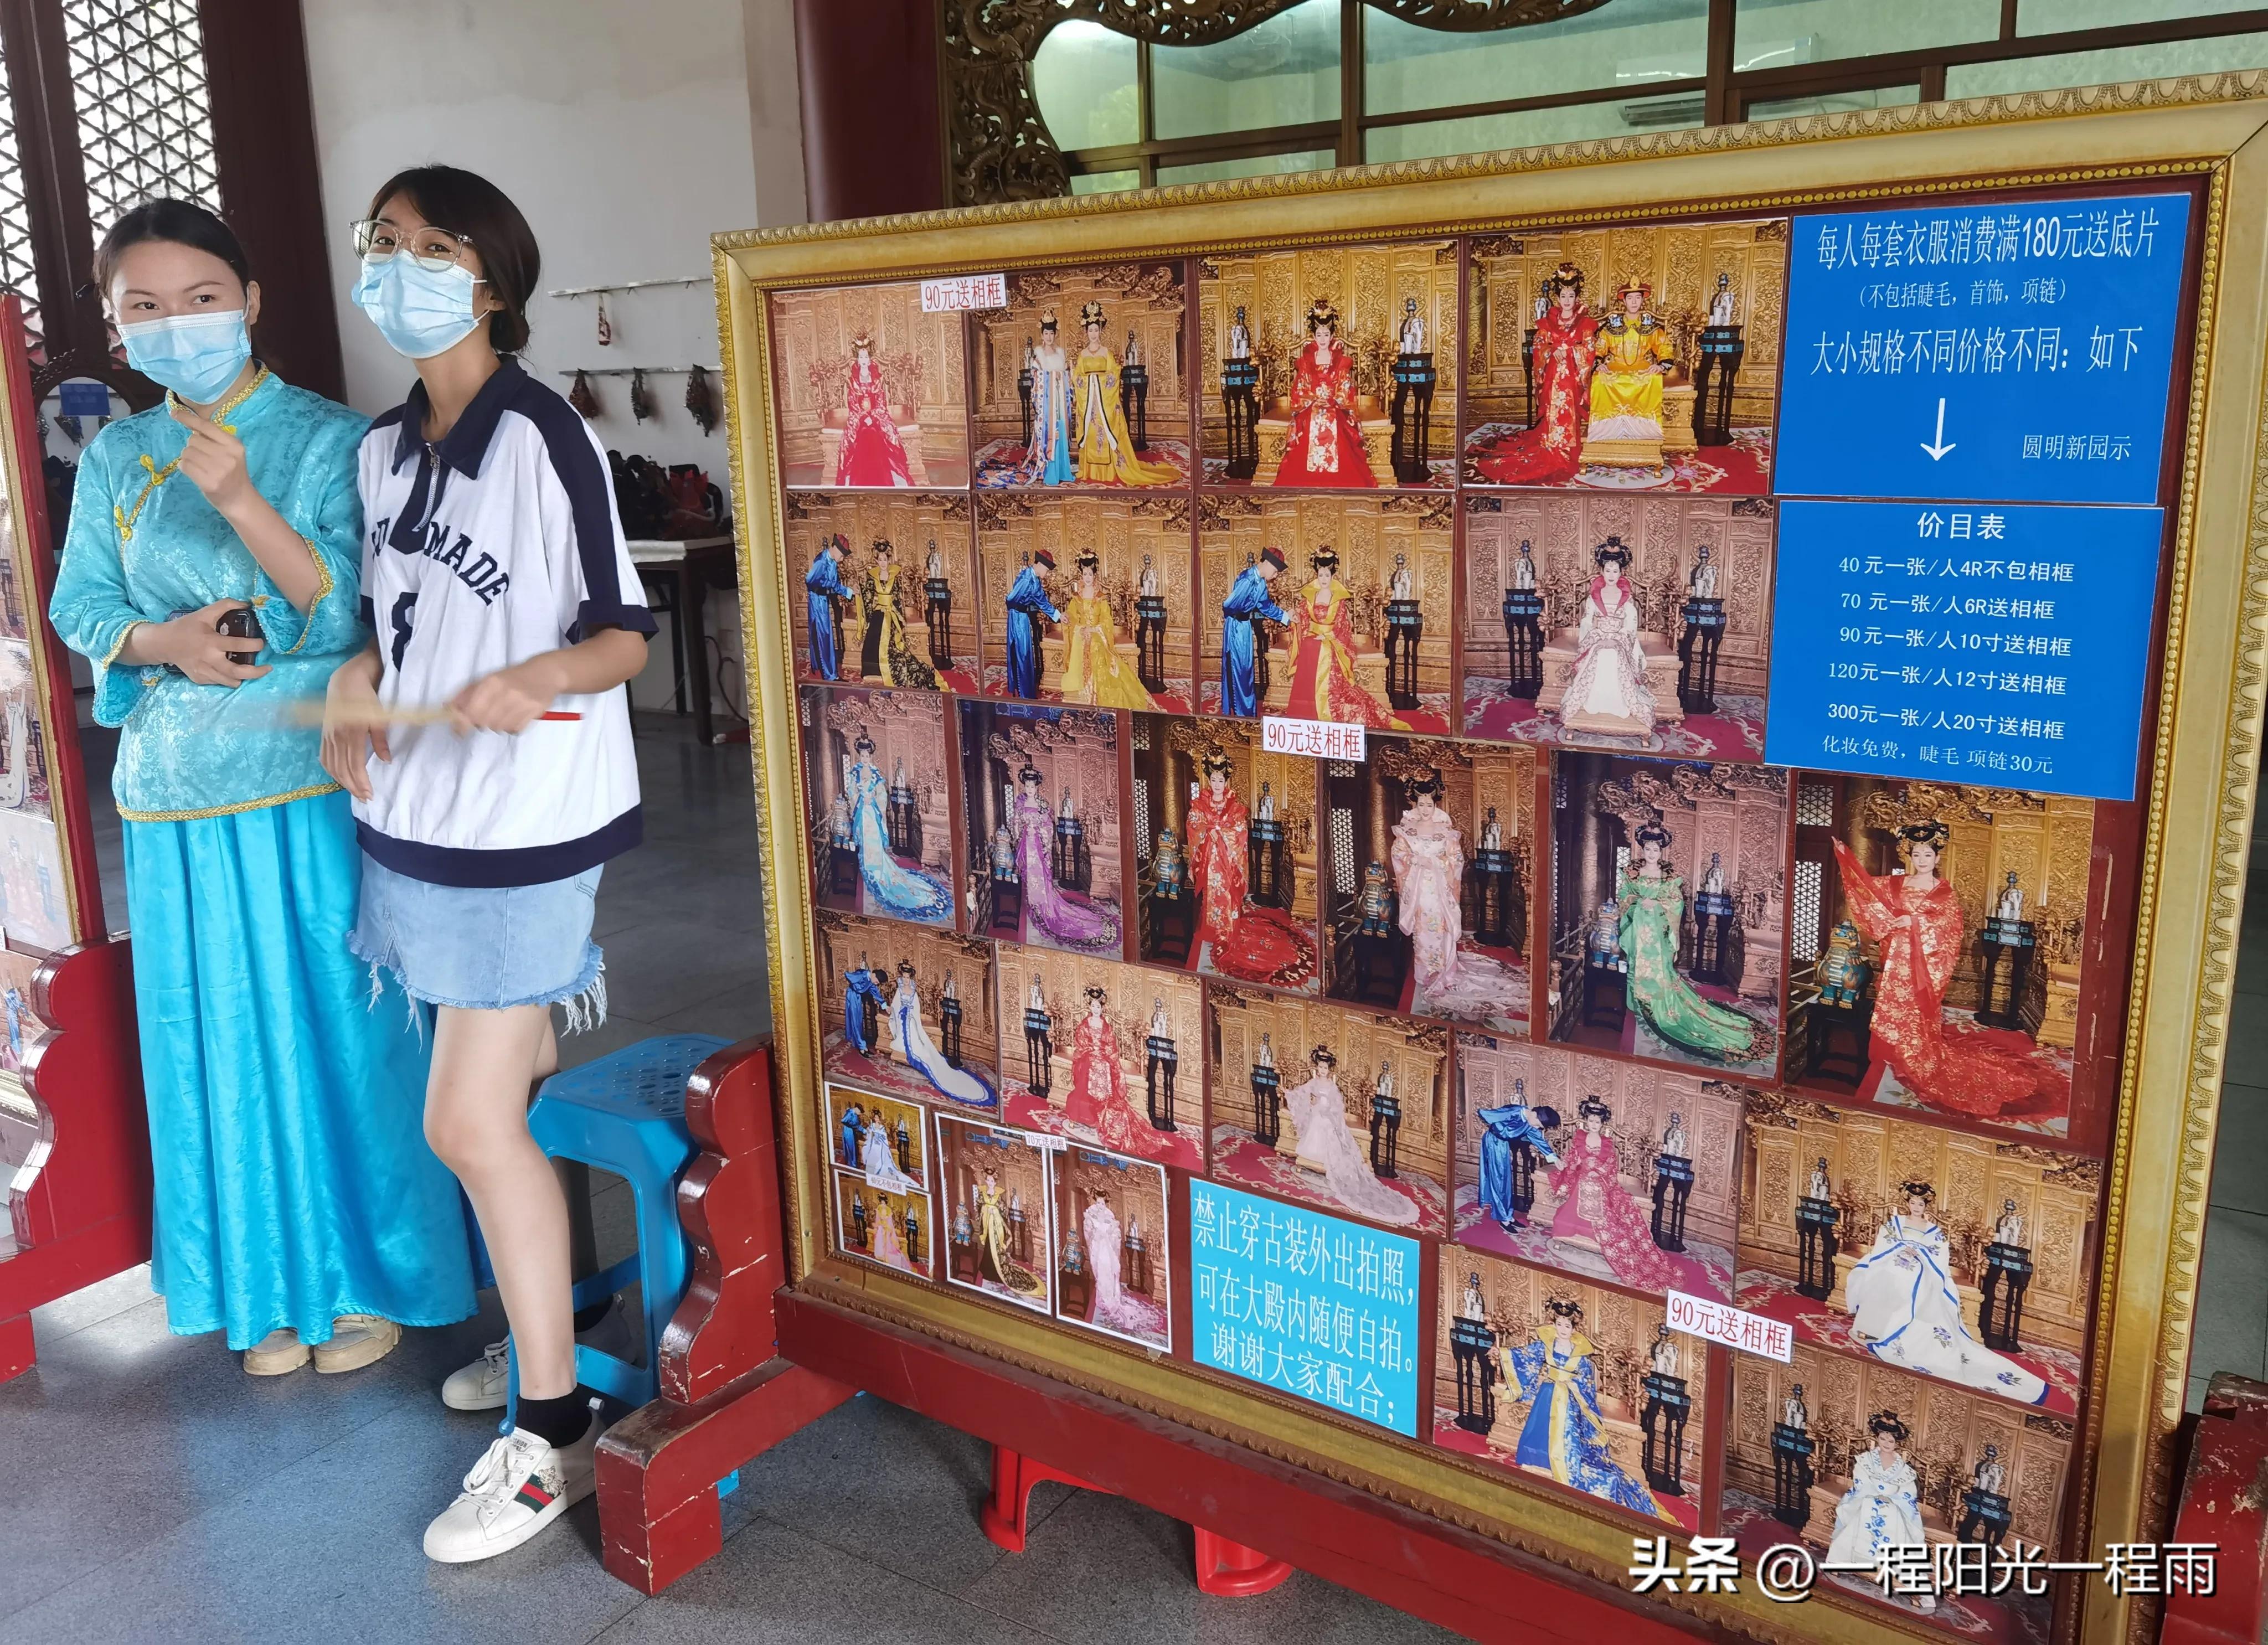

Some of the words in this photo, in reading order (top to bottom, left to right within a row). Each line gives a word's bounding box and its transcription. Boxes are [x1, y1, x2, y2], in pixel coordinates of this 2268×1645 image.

[1817, 208, 2159, 270] 每人每套衣服消费满180元送底片
[925, 276, 1002, 310] 90元送相框
[2022, 435, 2132, 461] 圆明新园示
[1918, 512, 2006, 540] 价目表
[1828, 663, 2066, 695] 120元一张/人12寸送相框
[1827, 704, 2065, 740] 300元一张/人20寸送相框
[1268, 723, 1360, 759] 90元送相框
[1194, 1190, 1414, 1306] 禁止穿古装外出拍照，
[1198, 1262, 1413, 1373] 可在大殿内随便自拍。
[1672, 1297, 1788, 1357] 90元送相框
[1211, 1321, 1394, 1425] 谢谢大家配合；
